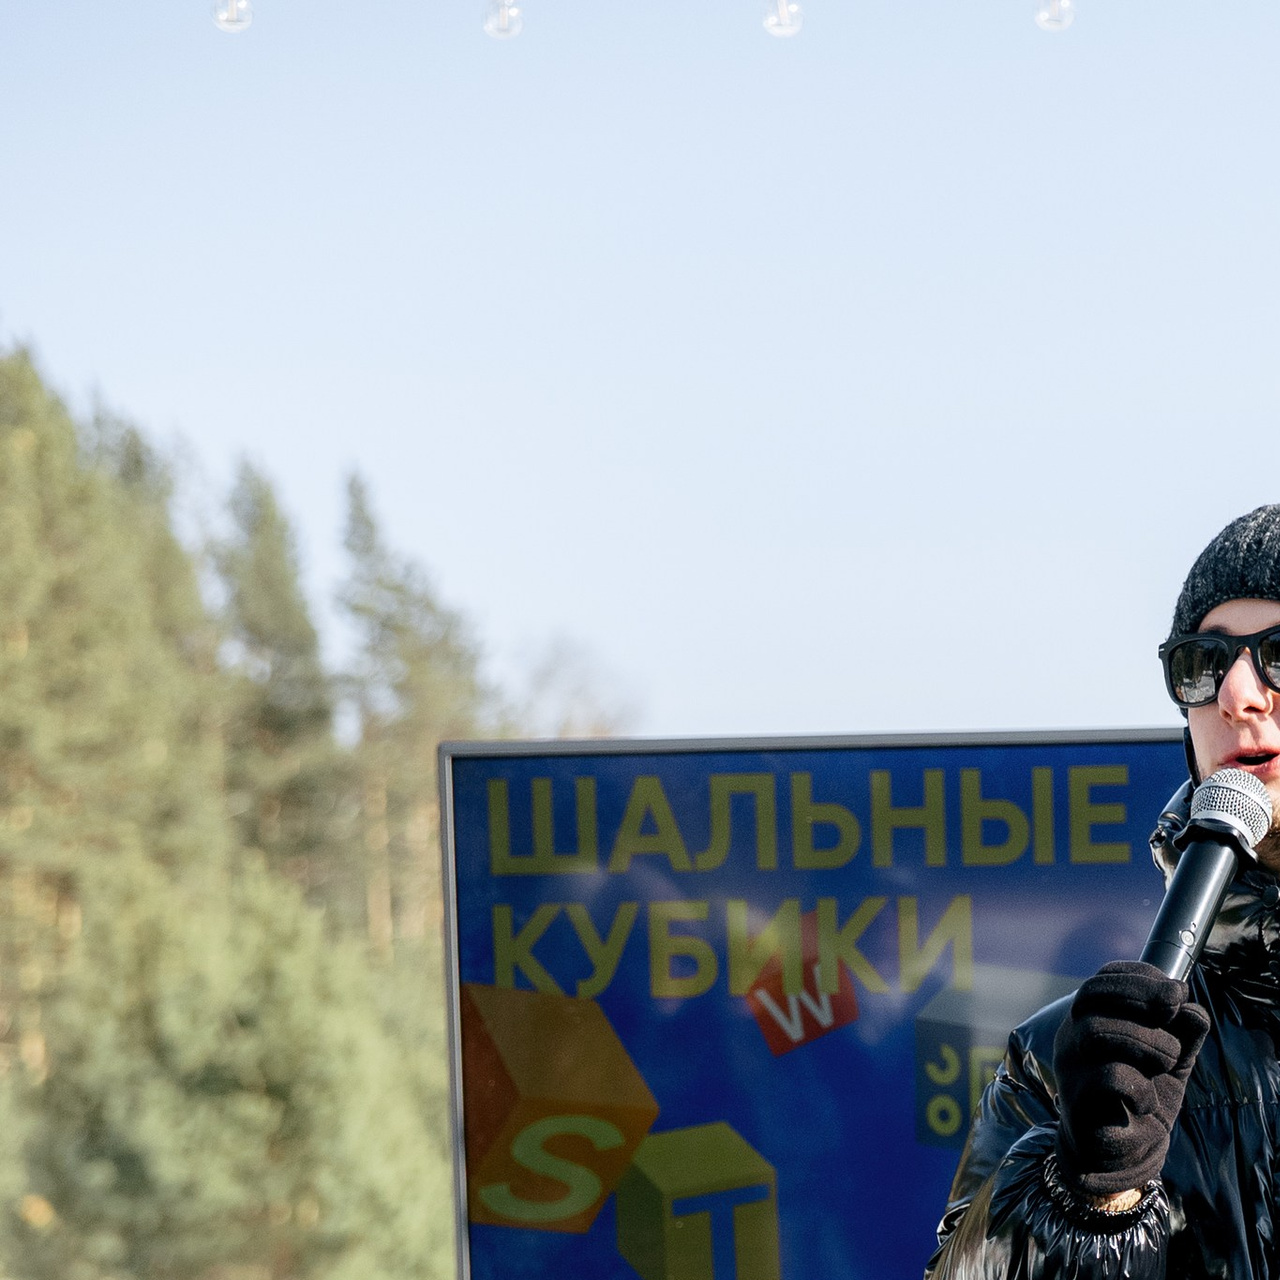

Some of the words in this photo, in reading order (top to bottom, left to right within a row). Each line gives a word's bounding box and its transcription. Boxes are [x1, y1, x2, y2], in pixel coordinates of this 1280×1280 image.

[487, 765, 1132, 875] ШАЛЬНЫЕ
[492, 895, 974, 999] КУБИКИ
[478, 1114, 625, 1222] S
